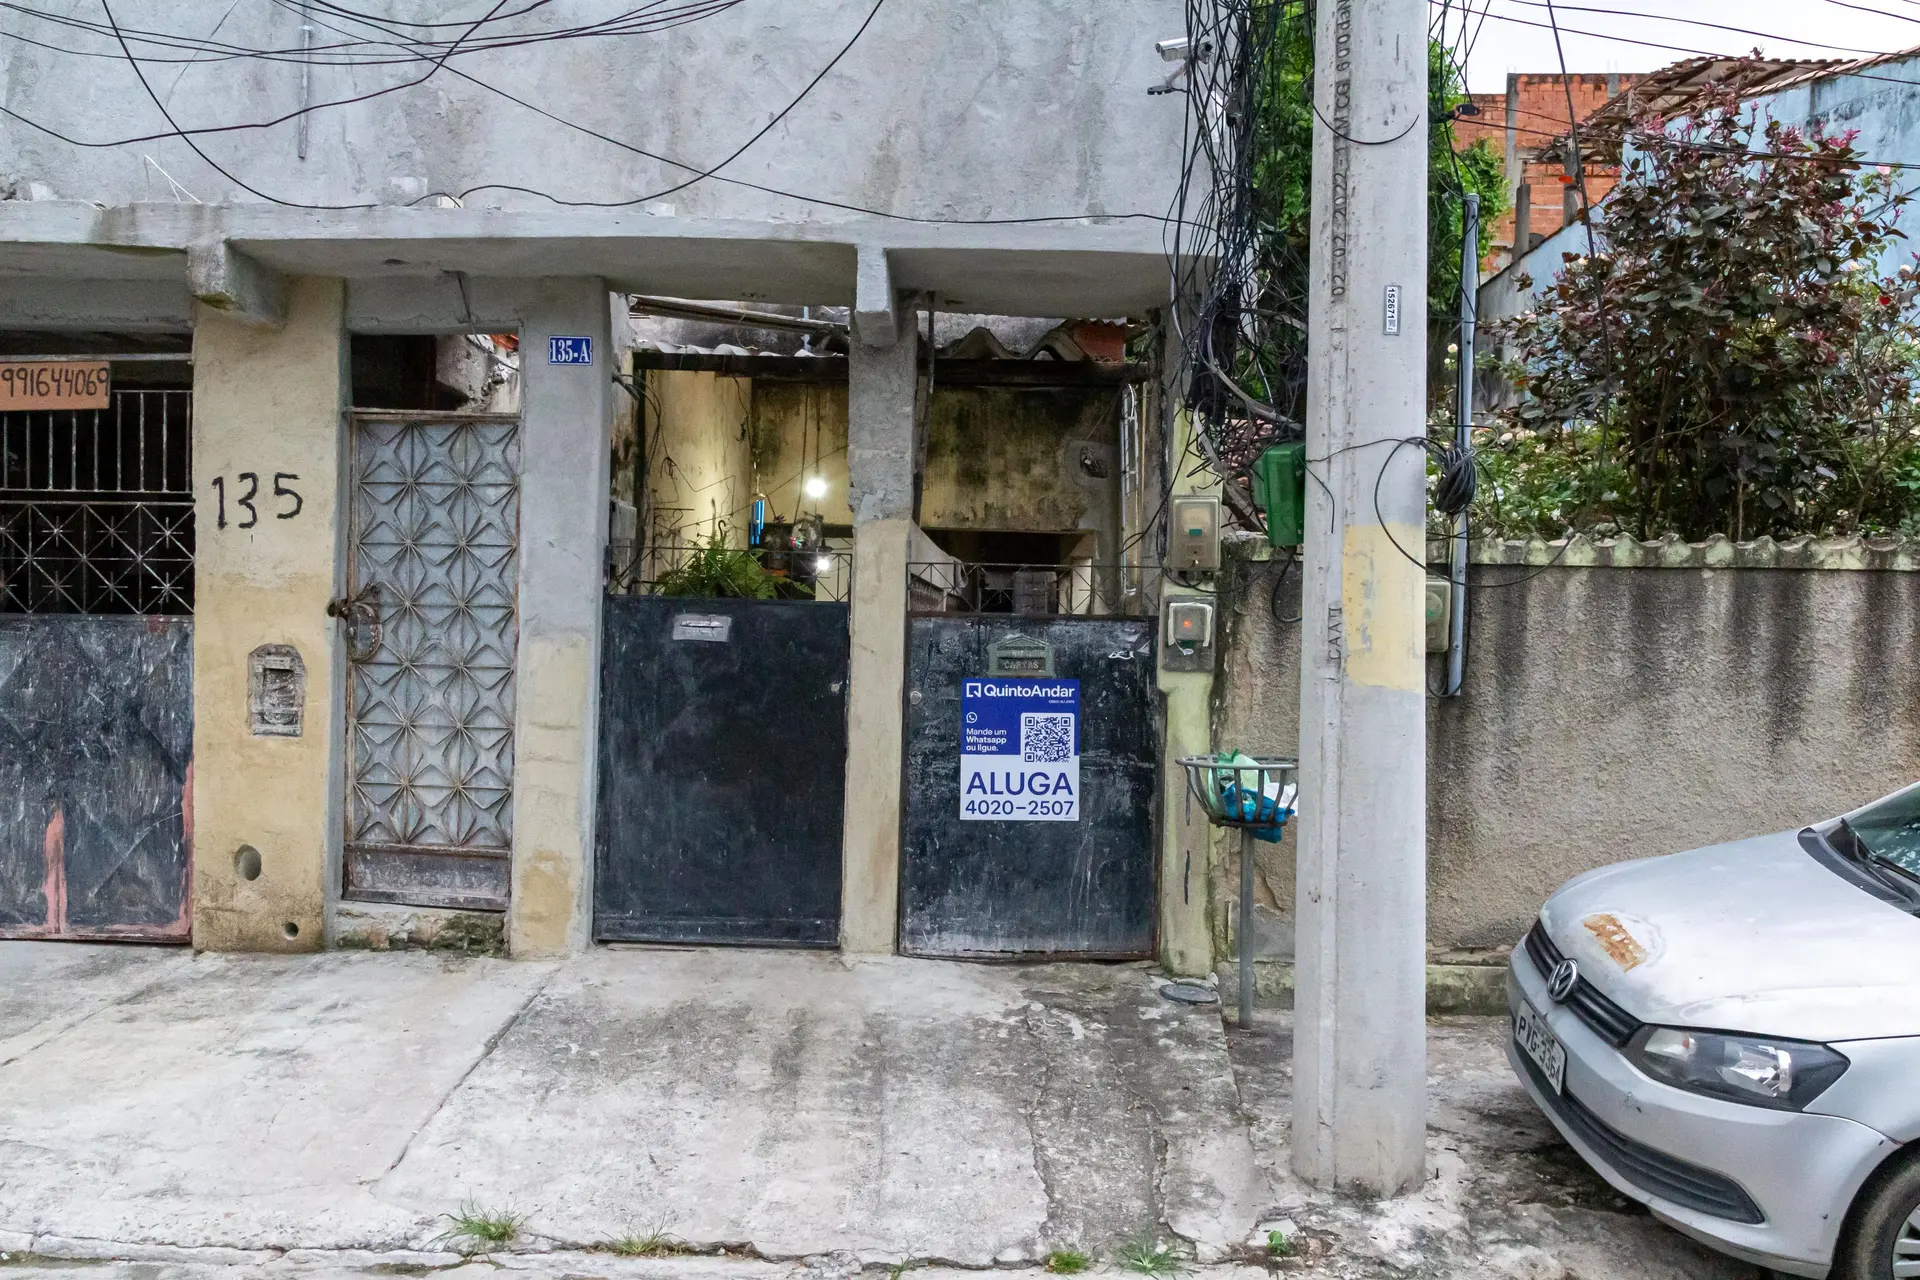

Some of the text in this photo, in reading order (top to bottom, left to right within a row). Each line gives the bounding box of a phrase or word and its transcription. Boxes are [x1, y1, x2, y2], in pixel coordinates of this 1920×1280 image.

[1387, 288, 1396, 319] 152671
[550, 339, 590, 362] 135-A
[1, 367, 108, 397] 991644069
[211, 472, 303, 530] 135
[984, 684, 1075, 697] QuintoAndar
[966, 728, 993, 736] Mande
[966, 736, 1007, 744] Whatsapp
[977, 744, 999, 753] ligue.
[966, 771, 1074, 795] ALUGA
[965, 800, 1074, 815] 4020-2507
